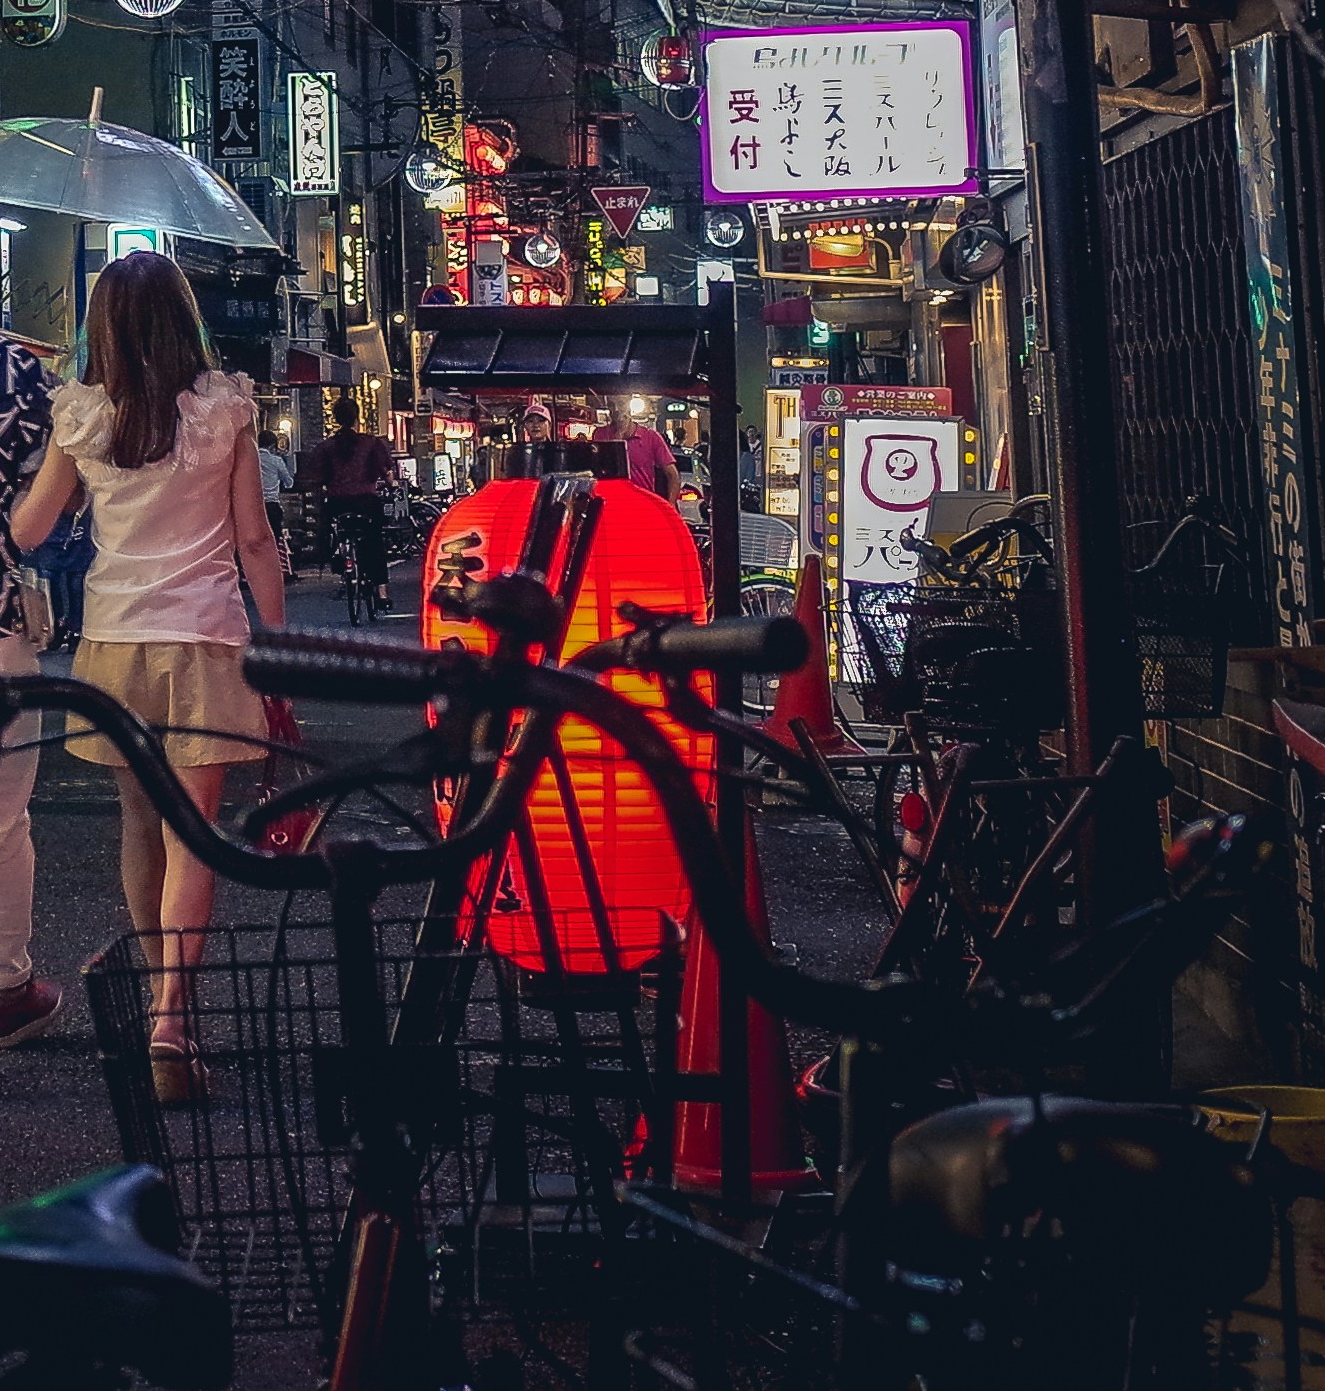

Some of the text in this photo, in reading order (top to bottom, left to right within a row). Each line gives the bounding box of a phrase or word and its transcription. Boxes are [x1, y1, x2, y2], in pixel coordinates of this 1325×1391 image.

[219, 46, 249, 142] 笑酔人
[728, 89, 762, 171] 受付
[772, 82, 805, 178] 鳥よし
[605, 196, 640, 209] 止まれ
